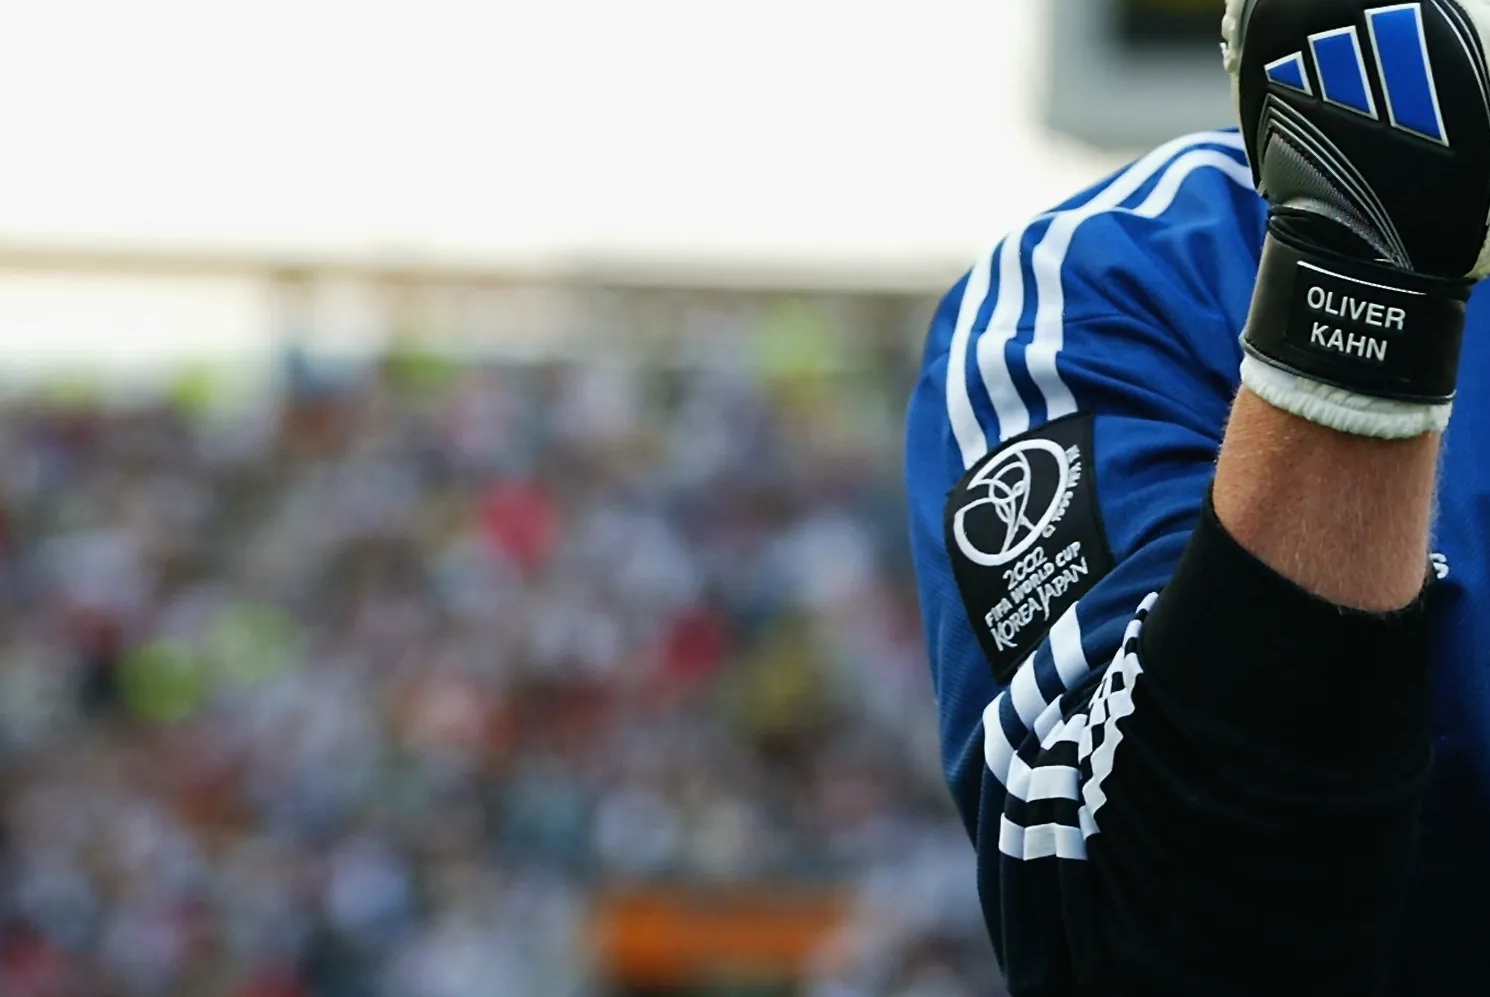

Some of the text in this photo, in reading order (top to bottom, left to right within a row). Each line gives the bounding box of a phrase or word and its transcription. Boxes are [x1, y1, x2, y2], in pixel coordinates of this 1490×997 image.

[1306, 286, 1406, 331] OLIVER
[1310, 322, 1388, 362] KAHN
[984, 541, 1081, 628] FIFA WORLD CUP
[1002, 546, 1048, 591] 2002
[990, 556, 1089, 651] KOREA JAPAN
